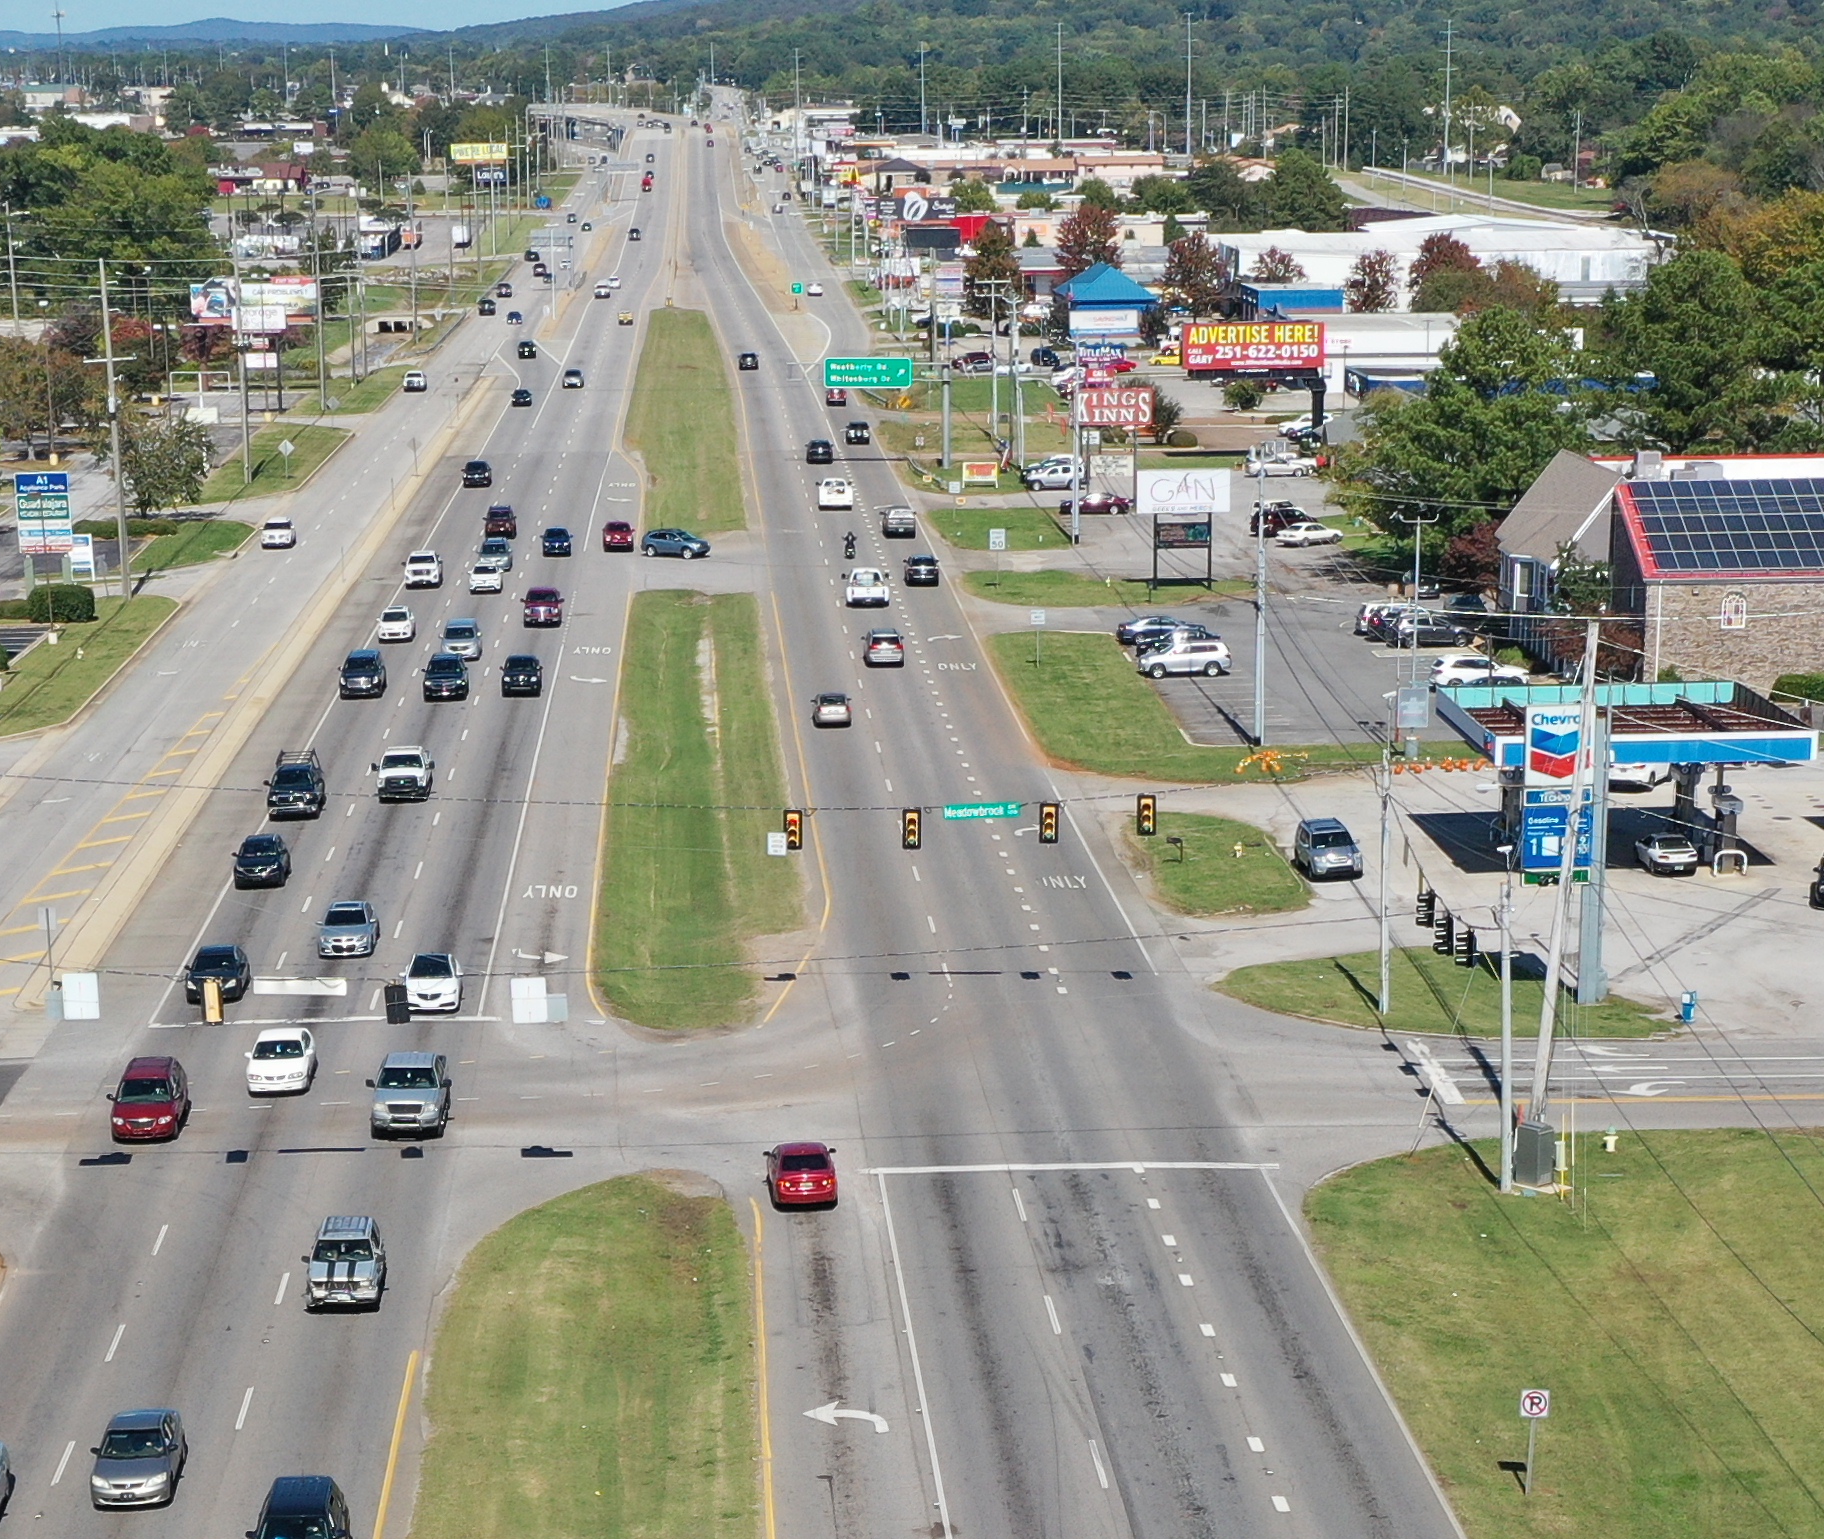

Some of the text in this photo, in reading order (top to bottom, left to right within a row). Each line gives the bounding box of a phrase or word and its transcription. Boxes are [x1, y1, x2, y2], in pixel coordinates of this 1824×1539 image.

[1188, 325, 1319, 344] ADVERTISE HERE!
[1215, 344, 1318, 359] 251-622-0150
[1189, 355, 1213, 364] GARY
[36, 476, 48, 484] A1
[991, 541, 1004, 549] 50
[573, 646, 611, 655] ONLY
[937, 662, 977, 670] ONLY
[1531, 713, 1581, 726] Chevro
[522, 884, 578, 898] ONLY
